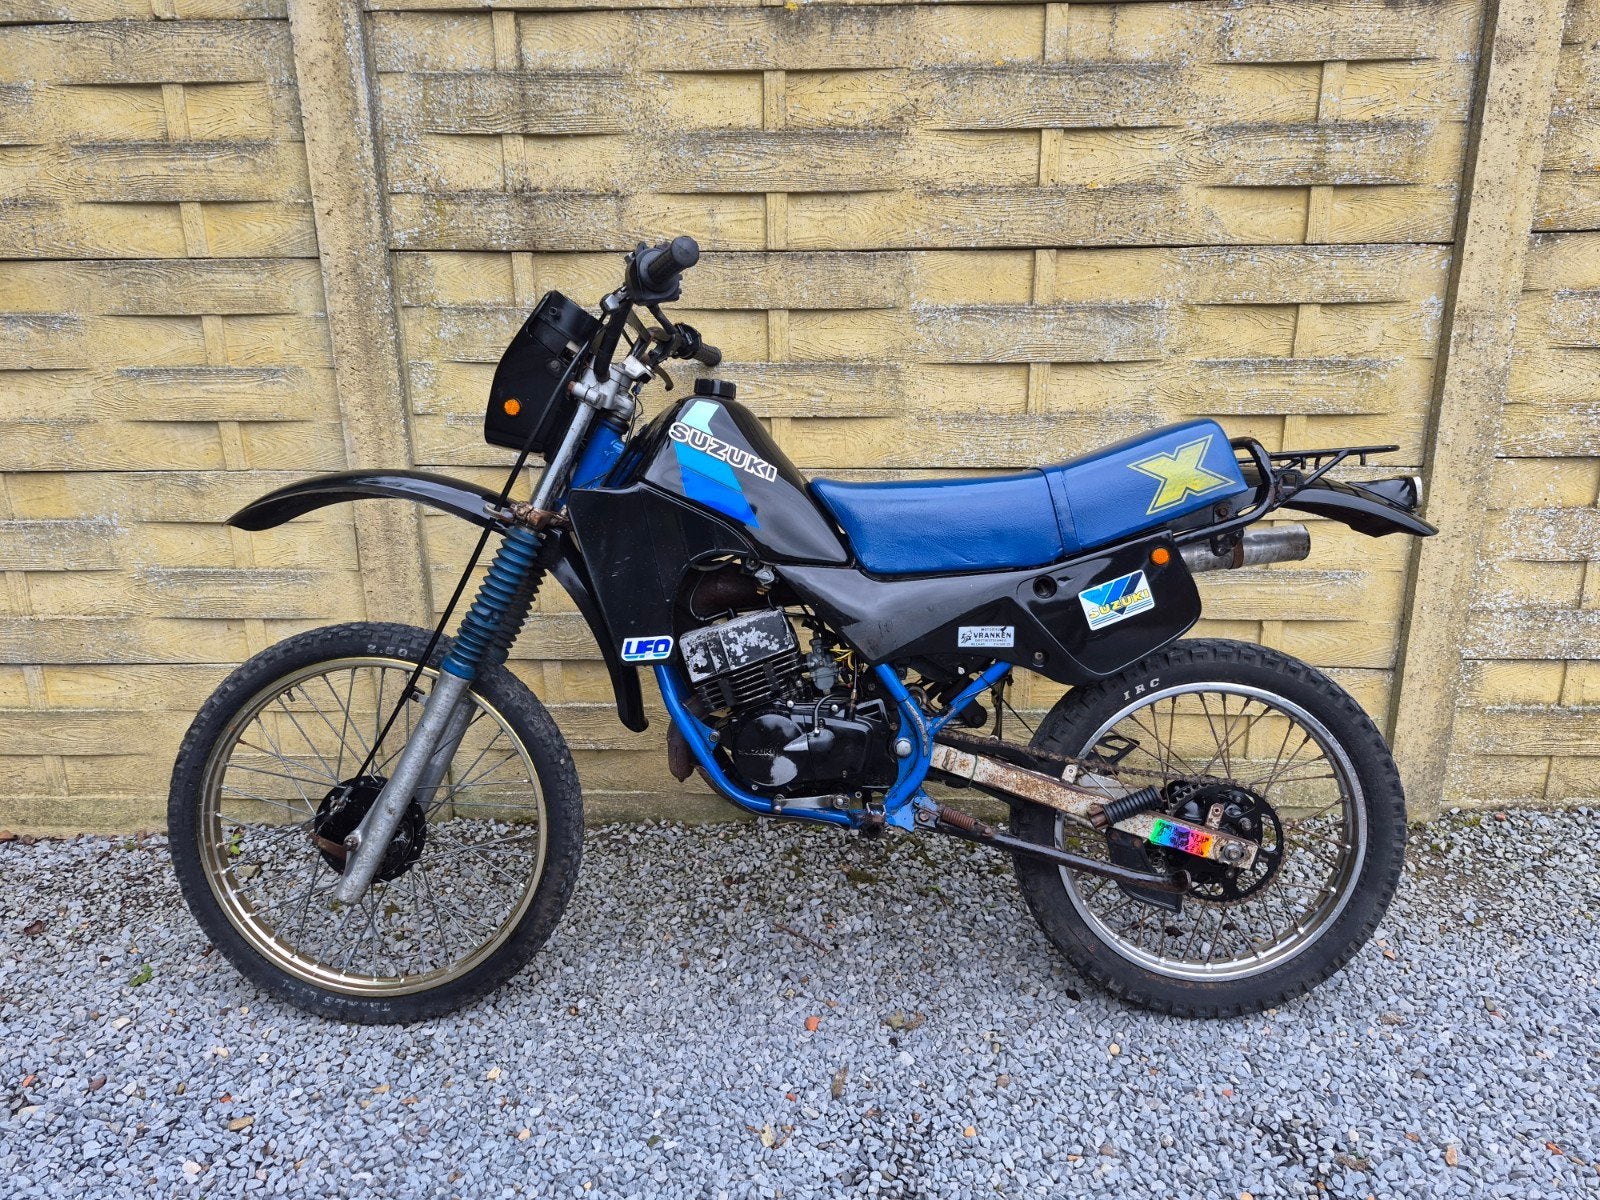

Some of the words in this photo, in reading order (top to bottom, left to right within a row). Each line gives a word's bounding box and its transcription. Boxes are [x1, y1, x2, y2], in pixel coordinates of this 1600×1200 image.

[668, 421, 778, 482] SUZUKI
[1088, 588, 1150, 619] SUZUKI
[624, 639, 671, 655] UFO
[1123, 677, 1160, 700] IRC
